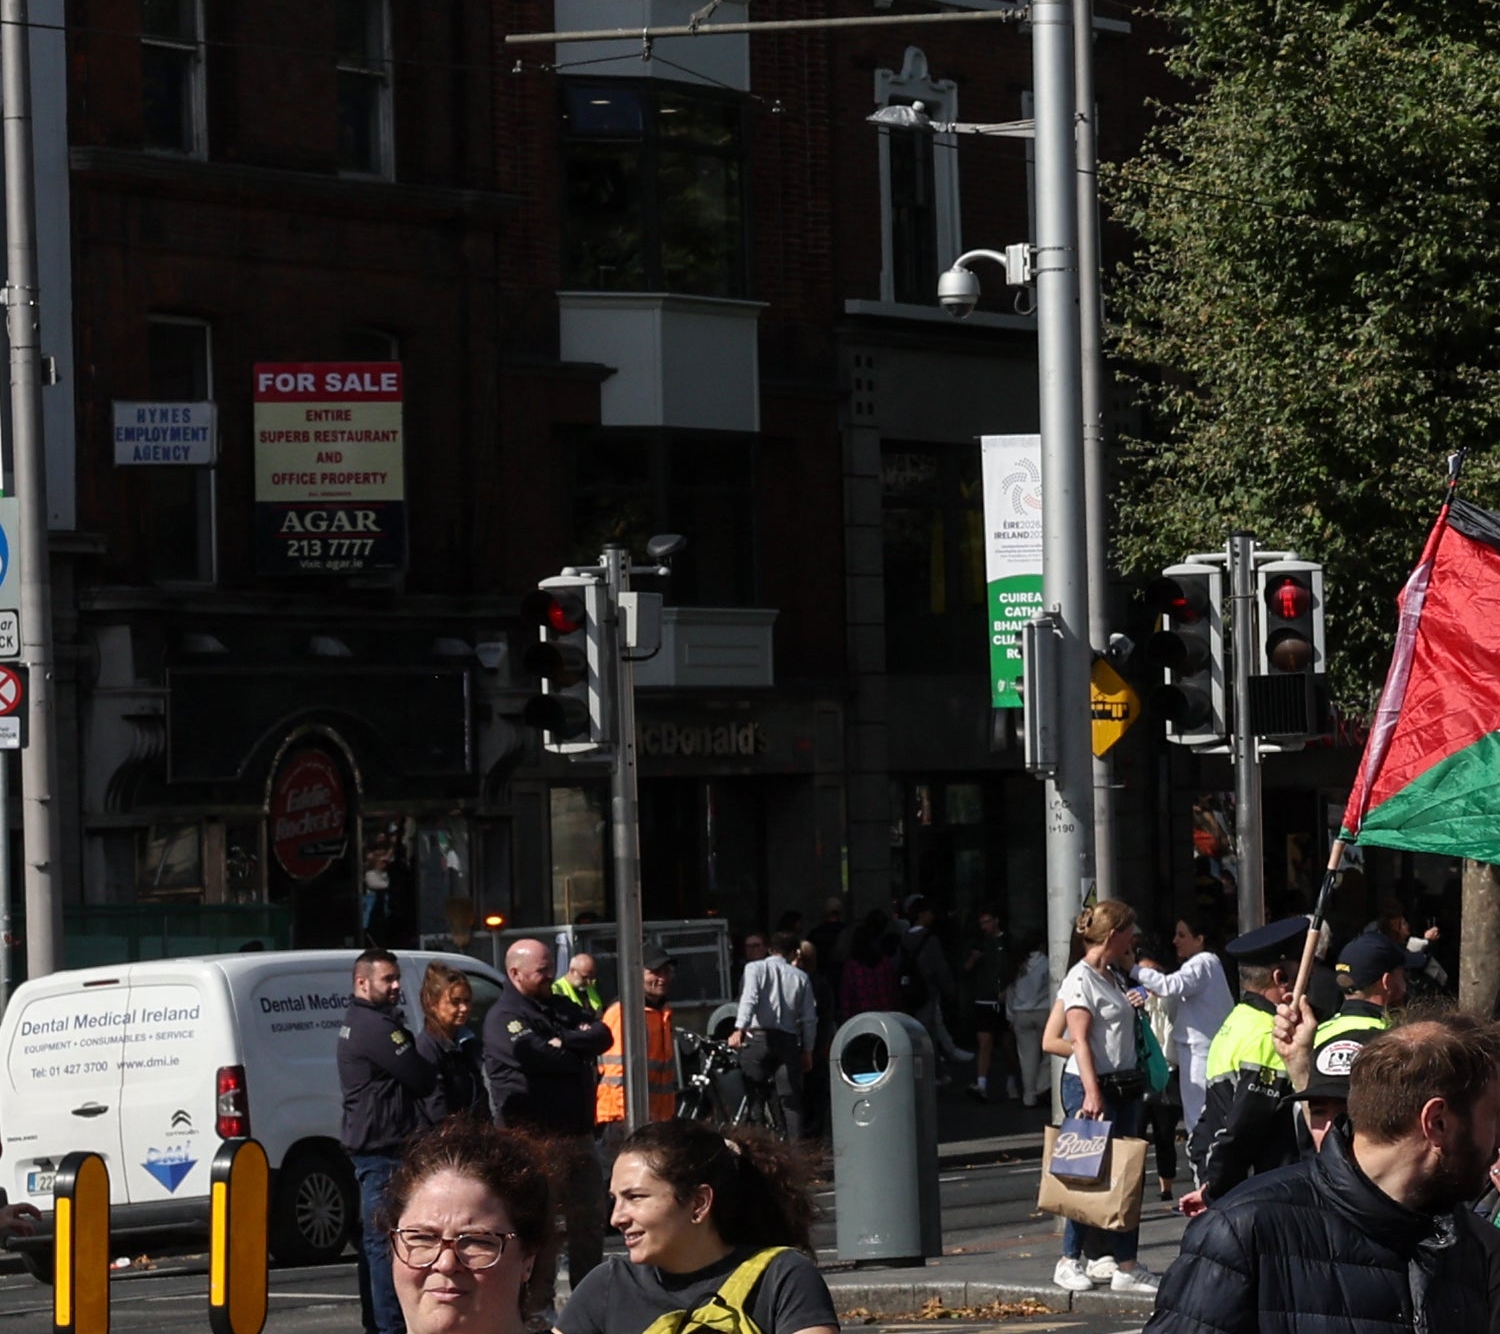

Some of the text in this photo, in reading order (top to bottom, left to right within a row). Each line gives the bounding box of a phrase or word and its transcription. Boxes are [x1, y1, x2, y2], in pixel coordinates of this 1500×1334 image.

[258, 372, 398, 392] FOR SALE
[136, 408, 191, 424] HYNES
[305, 410, 352, 422] ENTIRE
[115, 426, 209, 443] EMPLOYMENT
[259, 430, 399, 443] SUPERB RESTAURANT
[132, 445, 190, 461] AGENCY
[315, 452, 342, 464] AND
[271, 471, 387, 485] OFFICE PROPERTY
[280, 510, 382, 533] AGAR
[286, 539, 375, 557] 213 7777
[999, 592, 1043, 603] CUIREA
[260, 995, 307, 1014] Dental
[22, 1004, 200, 1037] Dental Medical Ireland
[24, 1029, 195, 1054] EQUIPMENT CONSUMABLES SERVICE
[31, 1054, 180, 1079] Tel: 01 427 3700 www.dmi.ie
[1247, 1083, 1280, 1099] GARDA
[1053, 1132, 1106, 1160] Boots
